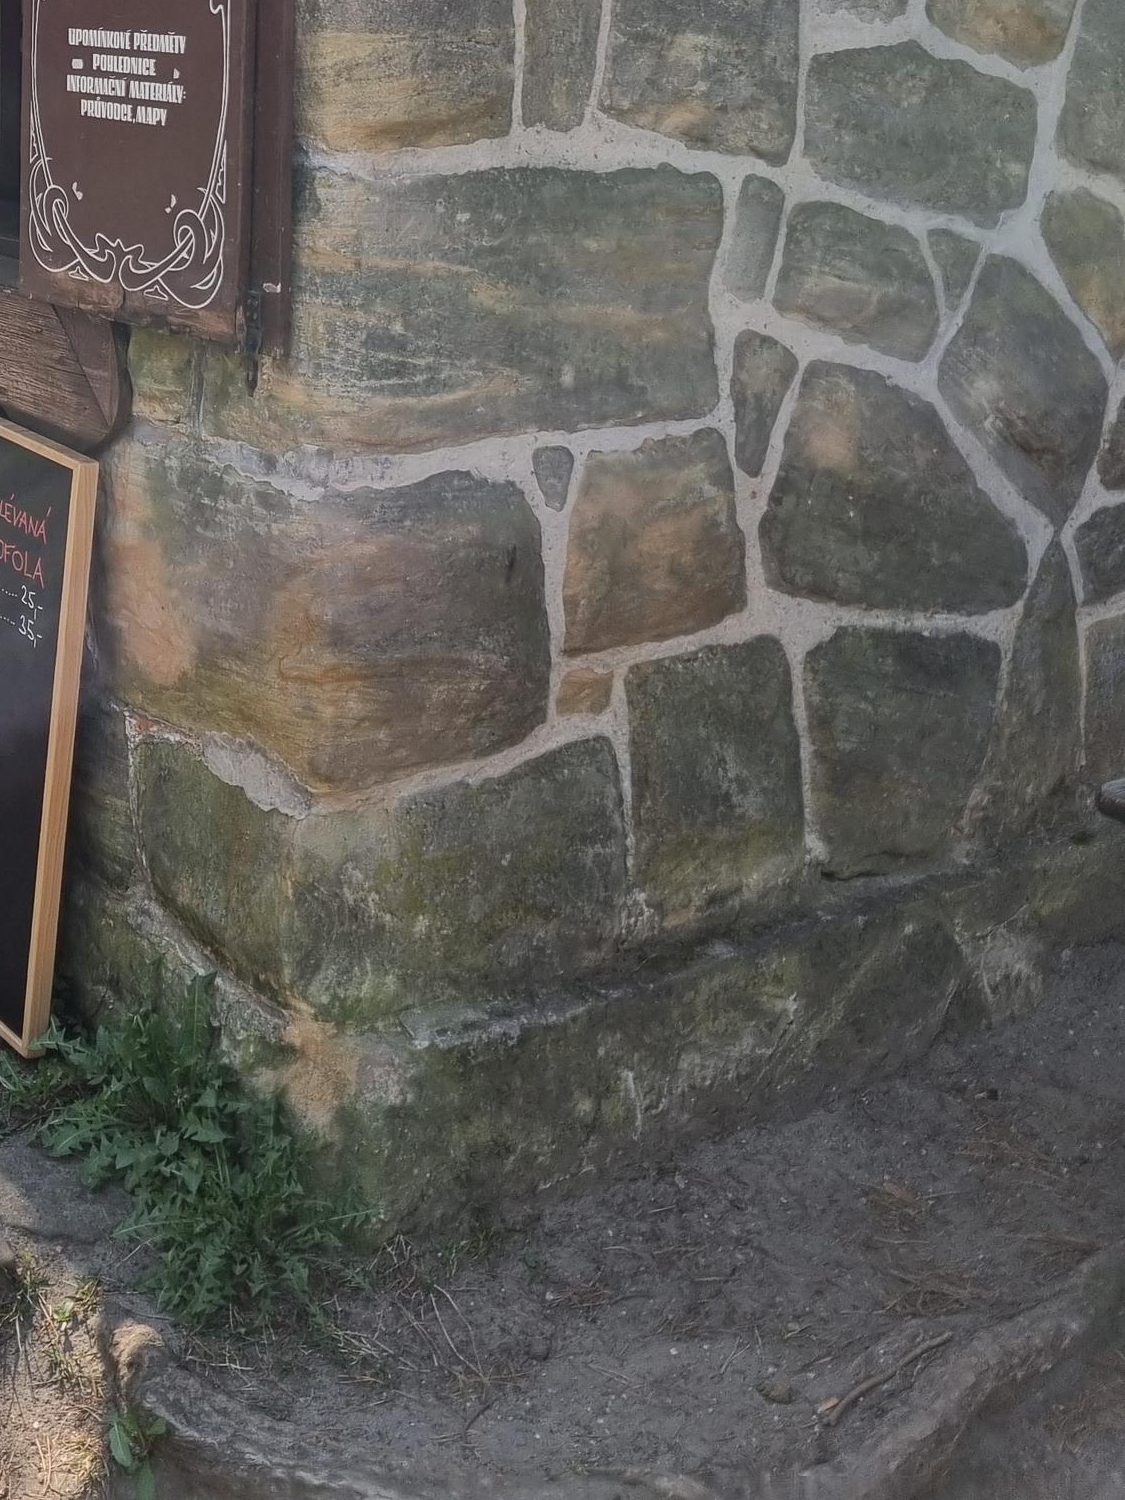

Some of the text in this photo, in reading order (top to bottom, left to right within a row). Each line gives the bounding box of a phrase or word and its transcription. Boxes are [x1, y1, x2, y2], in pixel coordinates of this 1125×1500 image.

[68, 27, 186, 54] UPOMÍNKOVÉ PŘEDMĚTY
[92, 53, 156, 76] POHLEDNICE
[66, 74, 127, 97] INFORMAČNÍ
